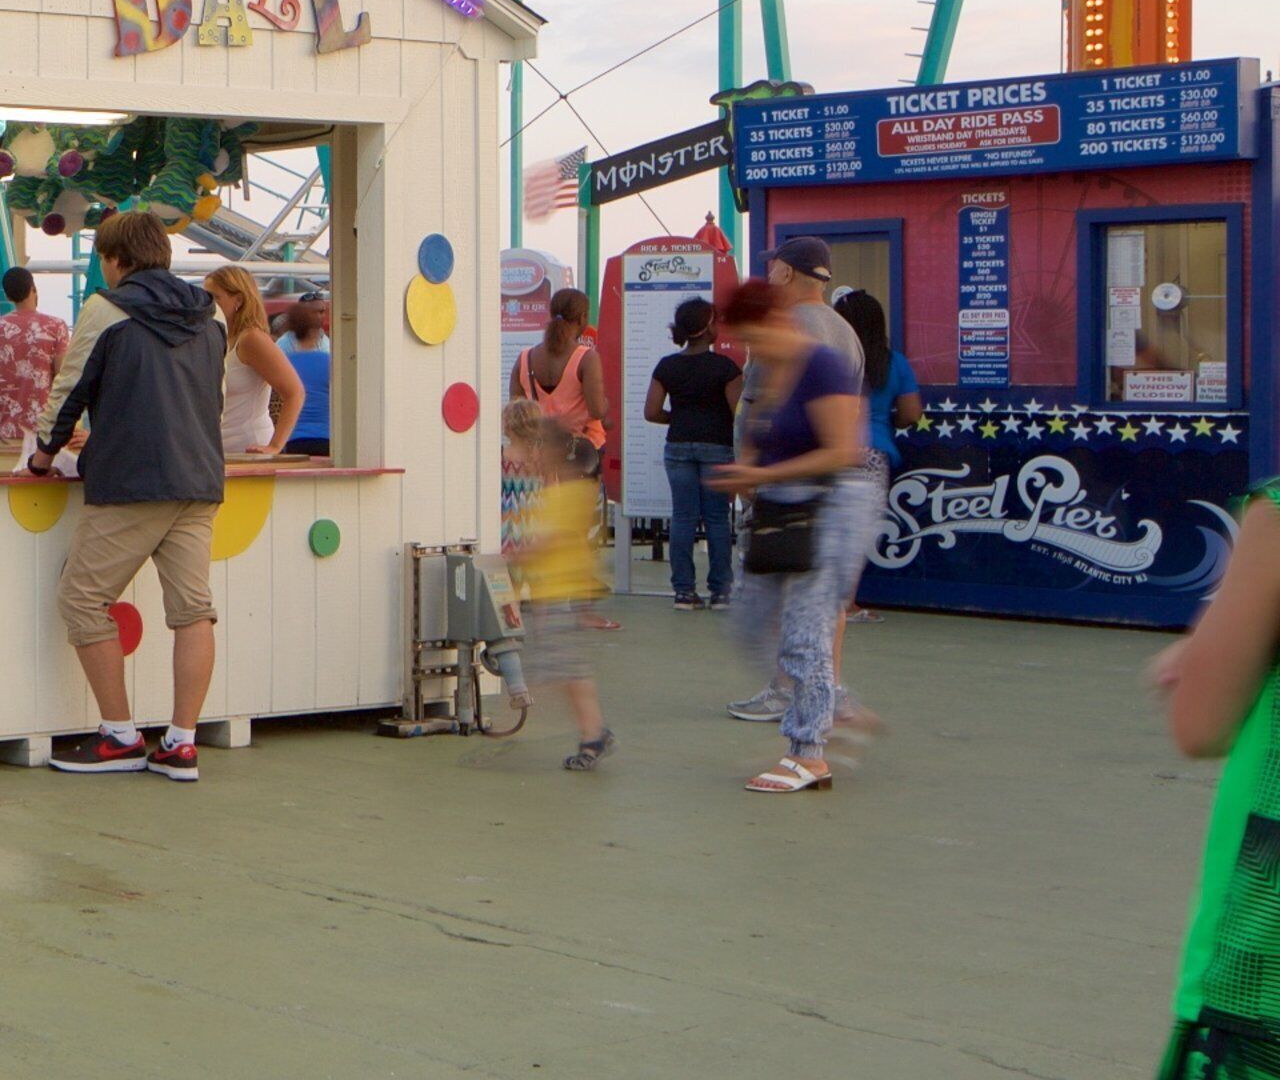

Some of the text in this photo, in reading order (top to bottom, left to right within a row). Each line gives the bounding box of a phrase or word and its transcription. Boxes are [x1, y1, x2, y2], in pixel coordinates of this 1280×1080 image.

[1102, 70, 1211, 91] 1 TICKET $1.00
[886, 82, 1046, 115] TICKET PRICES
[1086, 88, 1218, 113] 35 TICKETS $30.00
[762, 105, 849, 123] 1 TICKET $1.00
[891, 110, 1044, 135] ALL DAY RIDE PASS
[1087, 110, 1218, 135] 80 TICKETS $60.00
[750, 121, 855, 143] 35 TICKETS $30.00
[906, 126, 1027, 144] WRISTBAND DAY (THURSDAYS)
[751, 151, 767, 162] 80
[769, 147, 814, 160] TICKETS
[825, 141, 856, 153] $60.00
[936, 141, 967, 151] HOLIDAYS
[979, 138, 993, 147] ASK
[993, 137, 1006, 146] FOR
[1007, 136, 1032, 145] DETAILS
[1080, 132, 1225, 155] 200 TICKETS $120.00
[900, 158, 926, 167] TICKETS
[926, 156, 949, 165] NEVER
[950, 154, 972, 163] EXPIRE
[746, 168, 769, 180] 200
[771, 165, 816, 179] TICKETS
[826, 161, 863, 173] $120.00
[962, 192, 1005, 204] TICKETS
[971, 218, 996, 226] TICKET
[975, 235, 1005, 243] TICKETS
[638, 258, 671, 282] Steel
[975, 260, 1005, 268] TICKETS
[977, 284, 1007, 293] TICKETS
[1144, 375, 1174, 383] THIS
[1133, 391, 1184, 399] CLOSED
[865, 455, 1118, 570] Steel Pier
[1073, 559, 1111, 583] ATLANTIC
[1112, 574, 1132, 585] CITY
[1135, 572, 1148, 584] NJ
